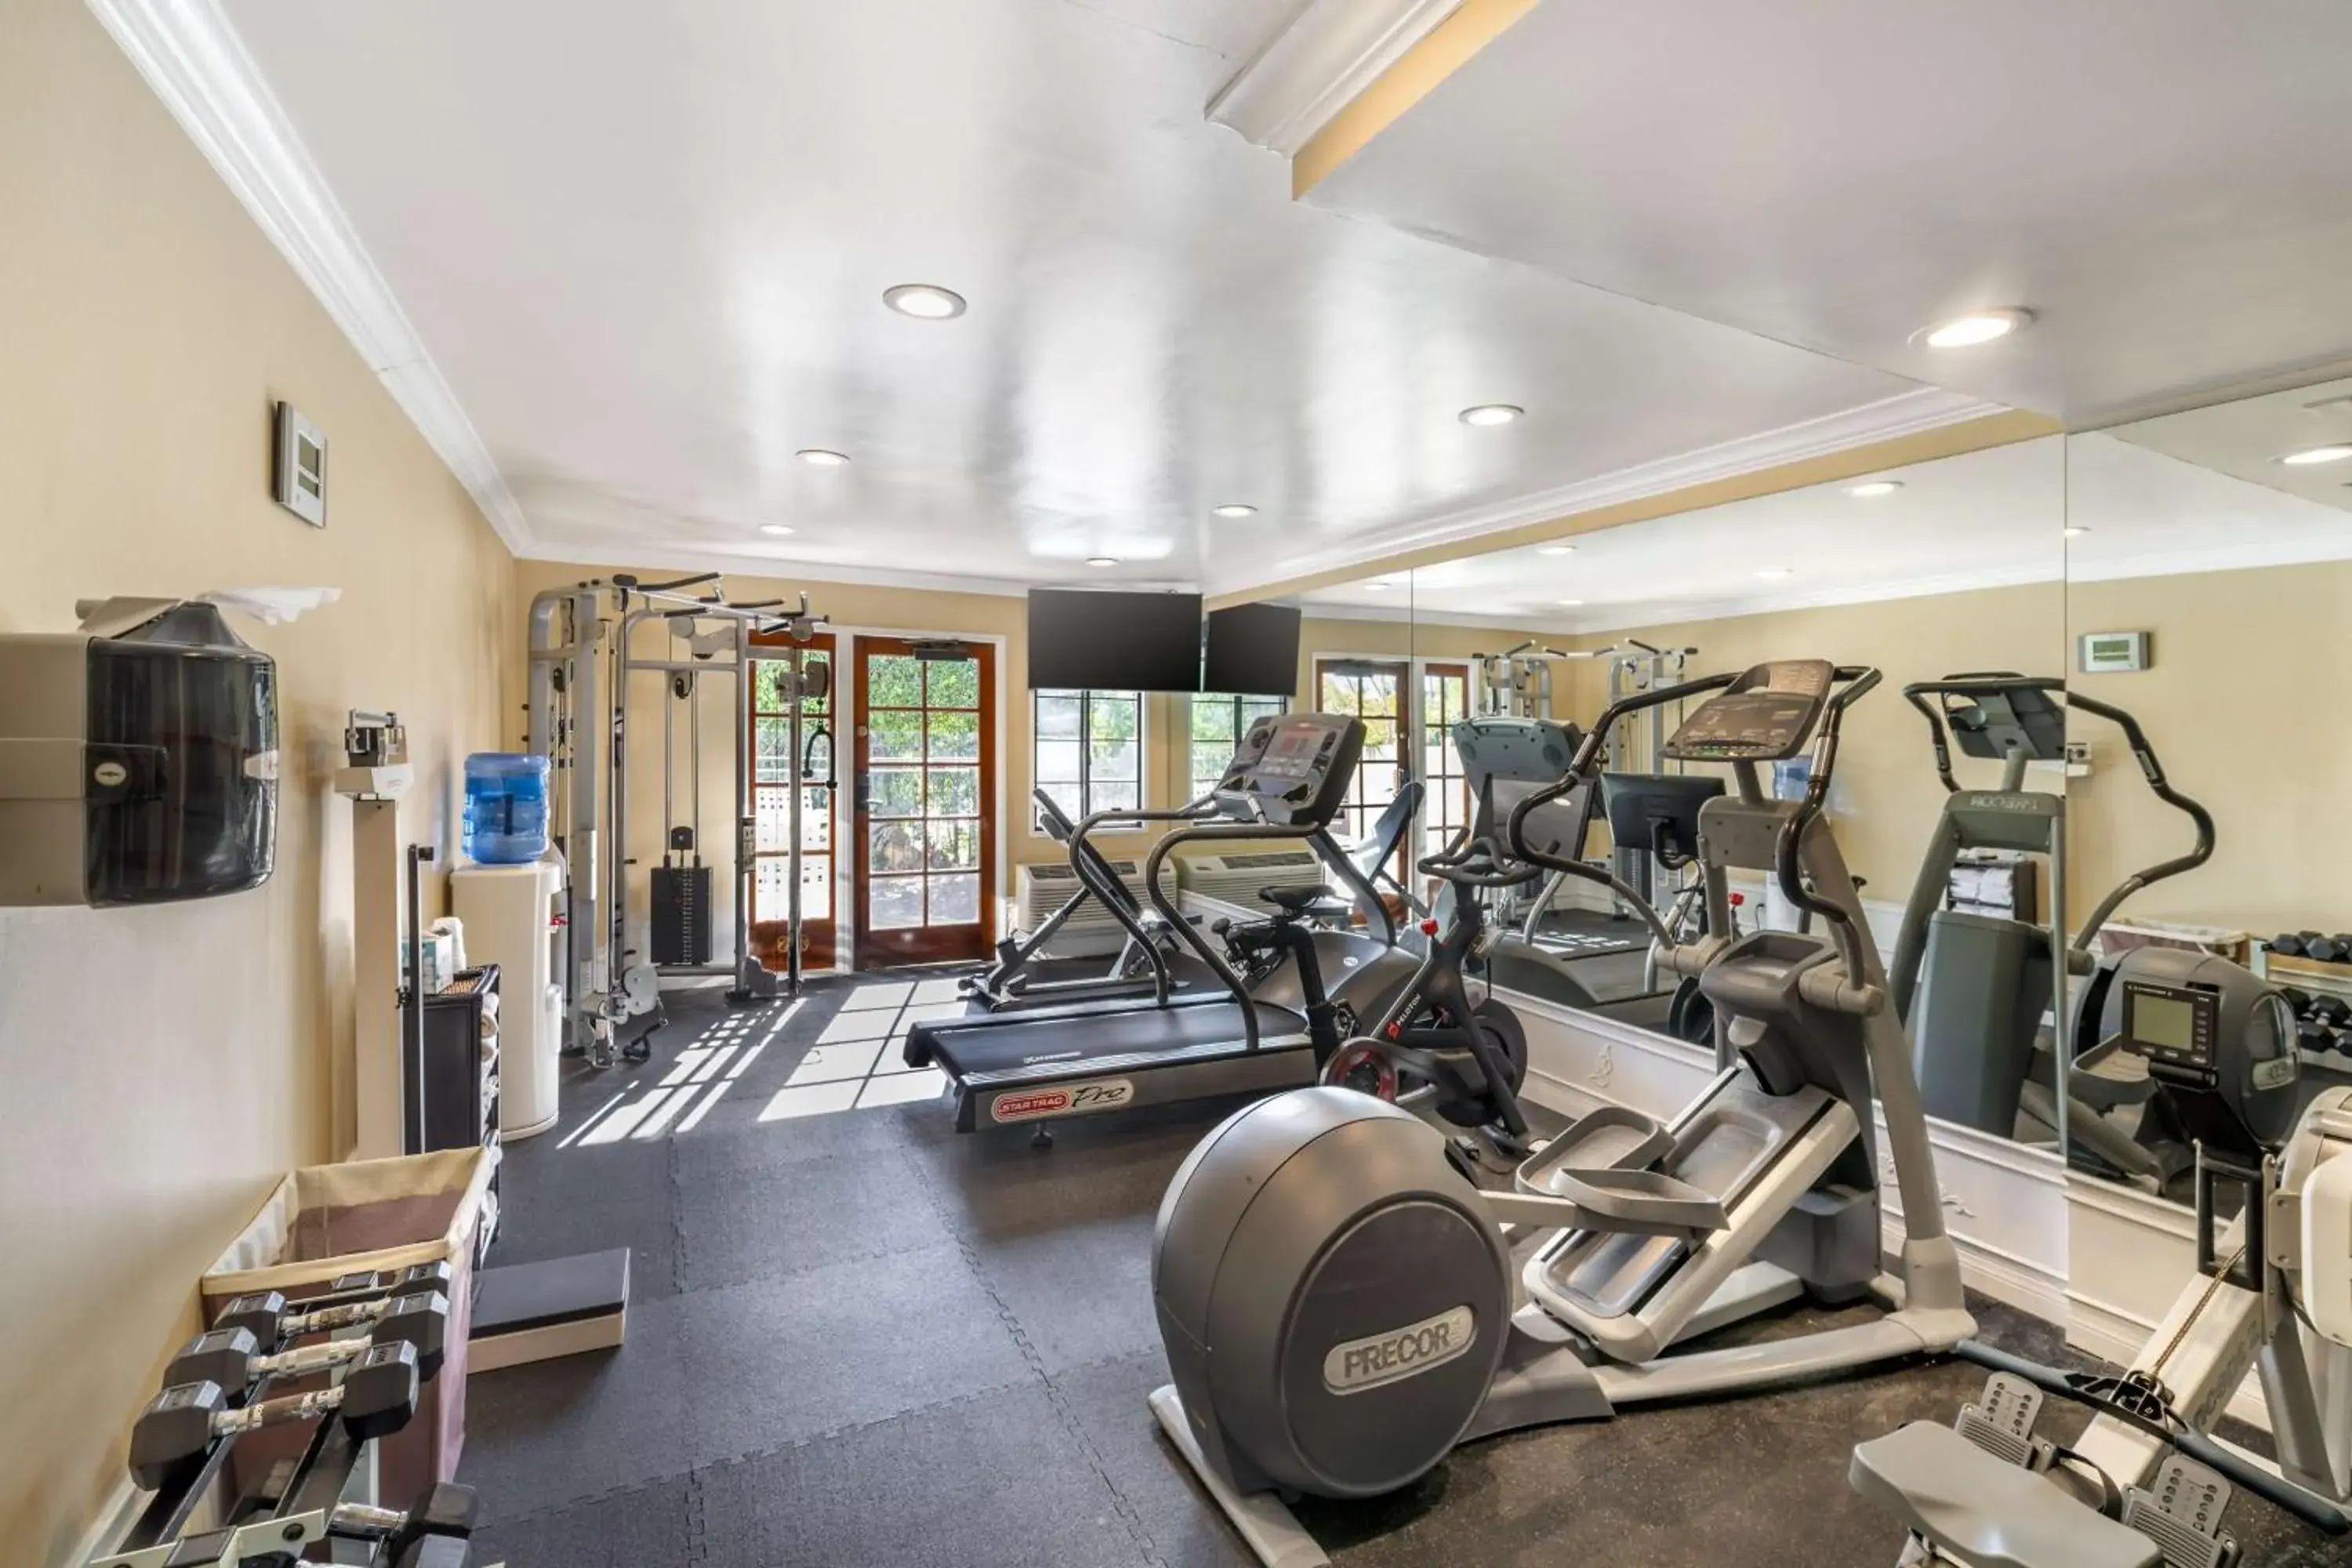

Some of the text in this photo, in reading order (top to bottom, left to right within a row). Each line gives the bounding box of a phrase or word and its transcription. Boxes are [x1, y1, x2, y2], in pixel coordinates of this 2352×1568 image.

[1396, 993, 1421, 1025] PELOTON
[1000, 1086, 1126, 1112] STAR TRAC Pro
[1344, 1322, 1450, 1379] PRECOR
